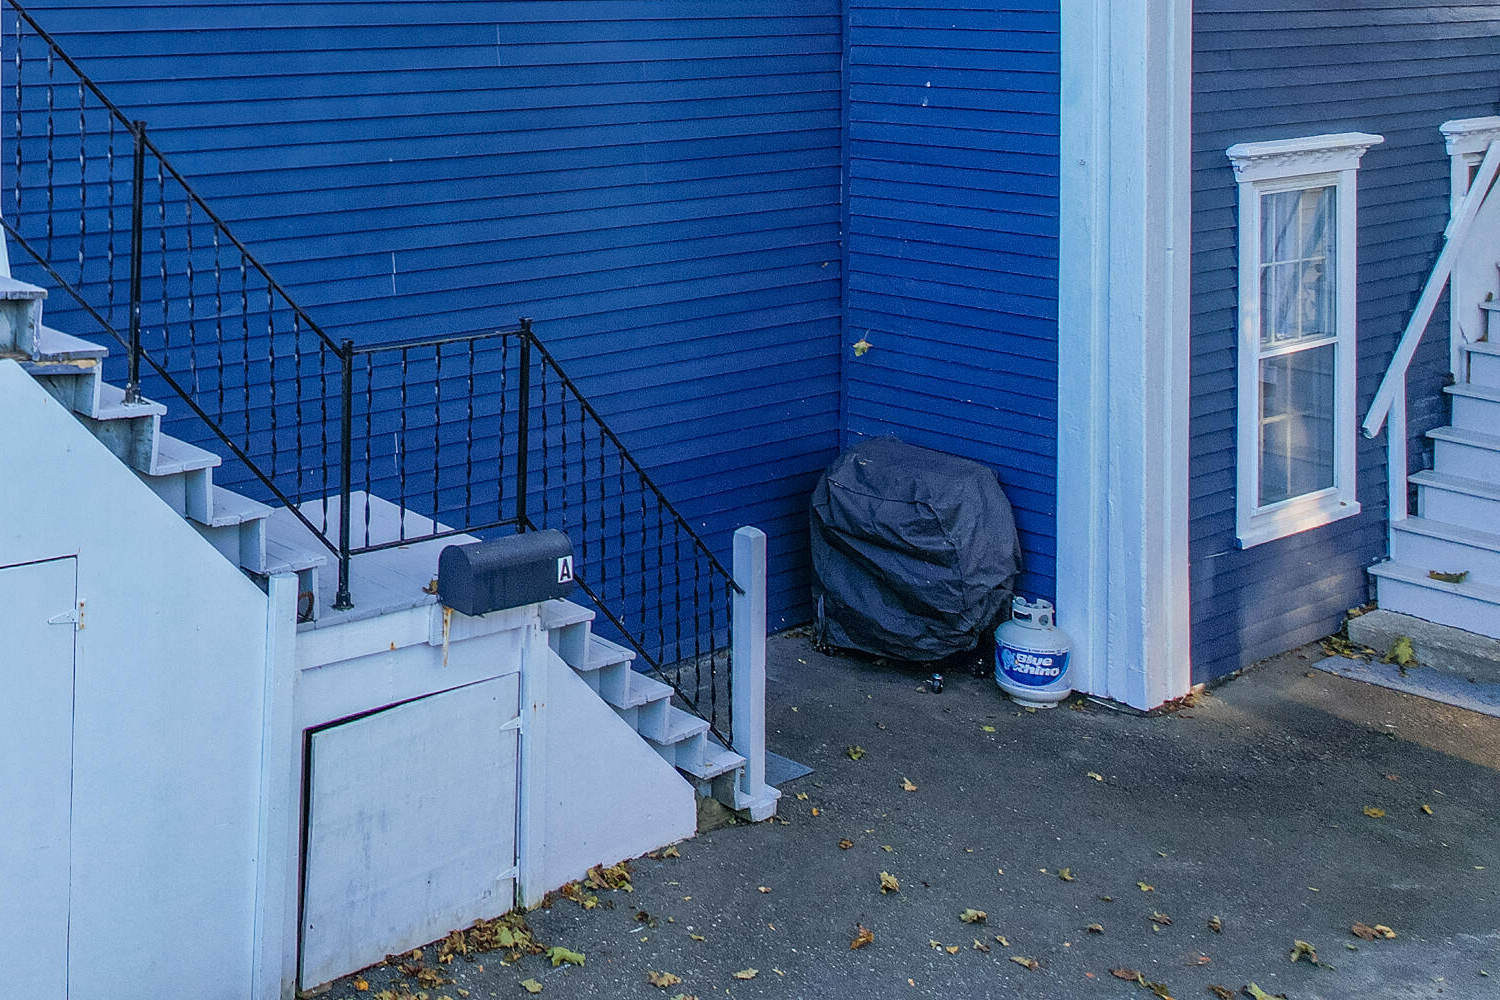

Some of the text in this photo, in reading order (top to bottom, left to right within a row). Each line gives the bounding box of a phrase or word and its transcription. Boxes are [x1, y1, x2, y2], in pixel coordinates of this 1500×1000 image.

[559, 558, 571, 582] A
[1016, 653, 1053, 666] Blue
[1013, 663, 1060, 677] Rhino
